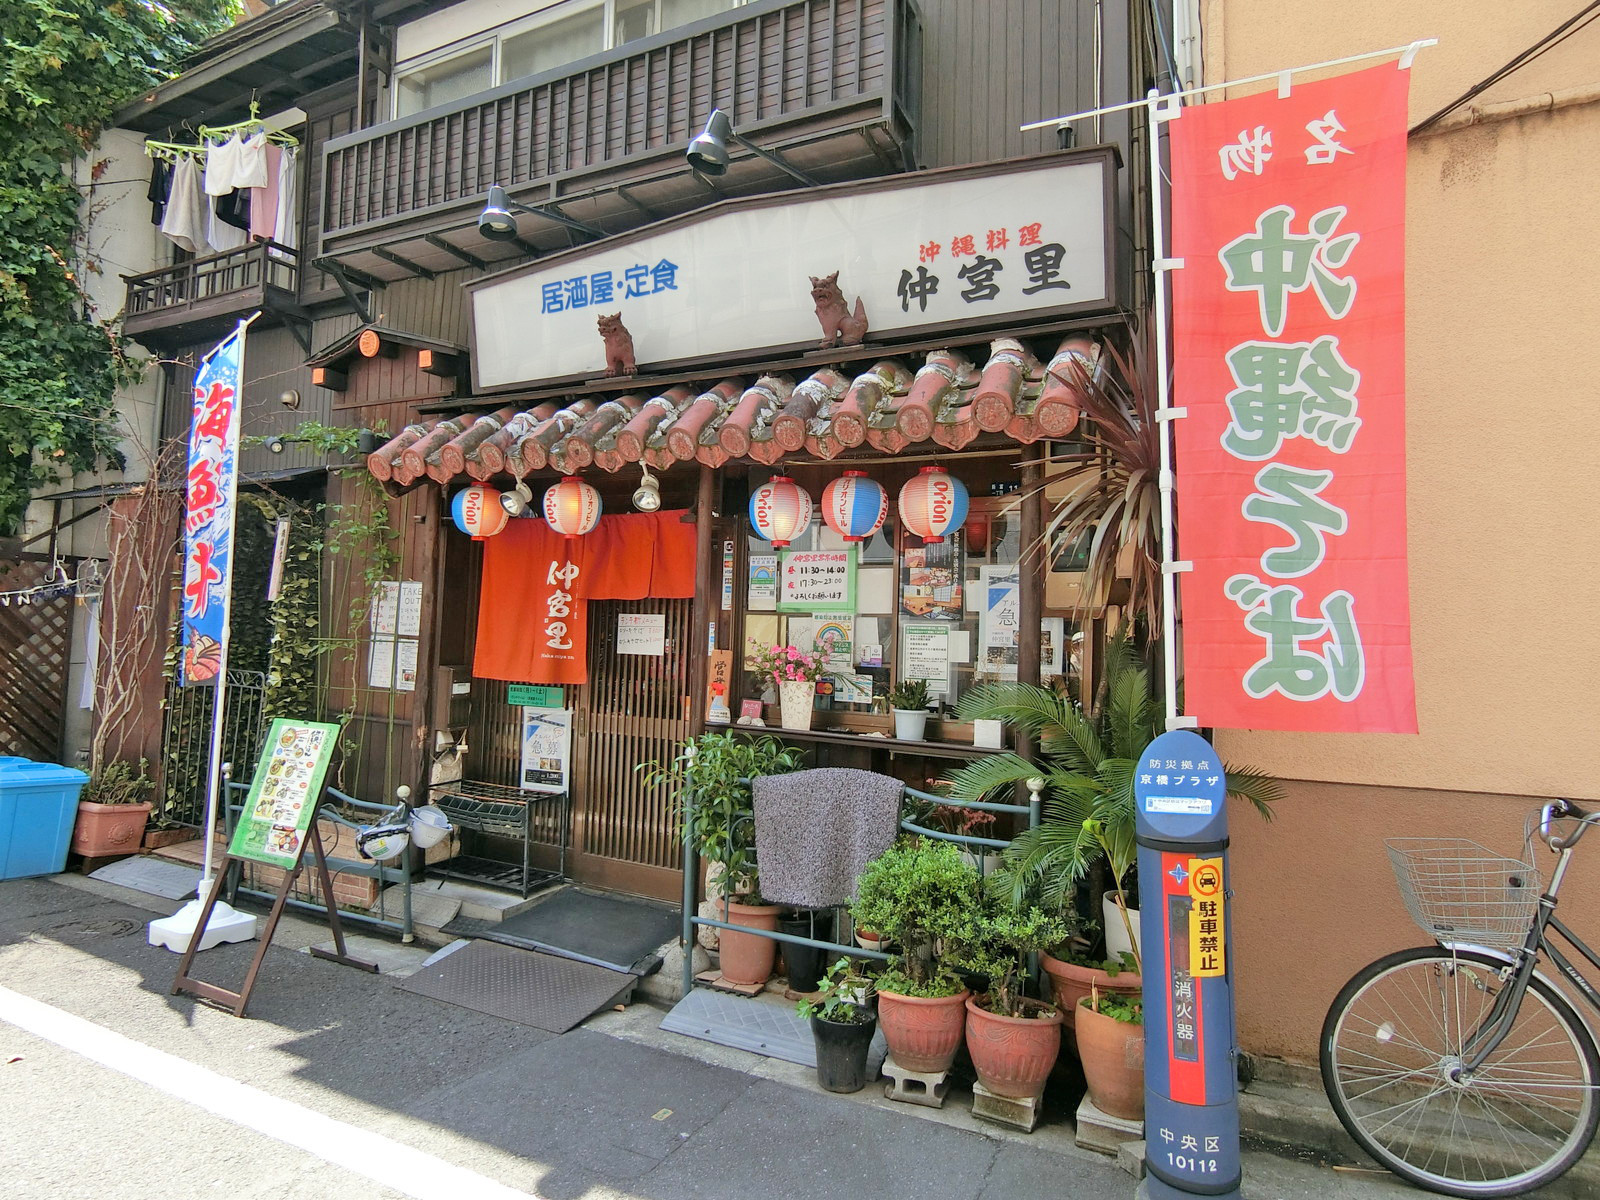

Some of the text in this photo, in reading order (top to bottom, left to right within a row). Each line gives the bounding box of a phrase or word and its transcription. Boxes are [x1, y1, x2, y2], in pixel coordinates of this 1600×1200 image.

[919, 222, 1043, 263] 沖縄料理
[897, 242, 1071, 312] 仲宮里
[465, 492, 481, 525] Orion
[546, 488, 557, 524] Orion
[757, 488, 772, 528] Orion
[839, 478, 852, 527] オリオンビール
[931, 481, 952, 524] Orion
[402, 587, 422, 596] TAKE
[404, 597, 421, 605] OUT
[544, 559, 580, 650] 仲宮里
[998, 607, 1017, 626] 急
[1140, 774, 1219, 787] 京橋プラザ
[1149, 758, 1210, 770] 防災拠点
[1198, 900, 1218, 971] 駐車禁止
[1174, 980, 1194, 1040] 消火器
[1159, 1127, 1220, 1152] 中央区
[1167, 1151, 1218, 1173] 10112
